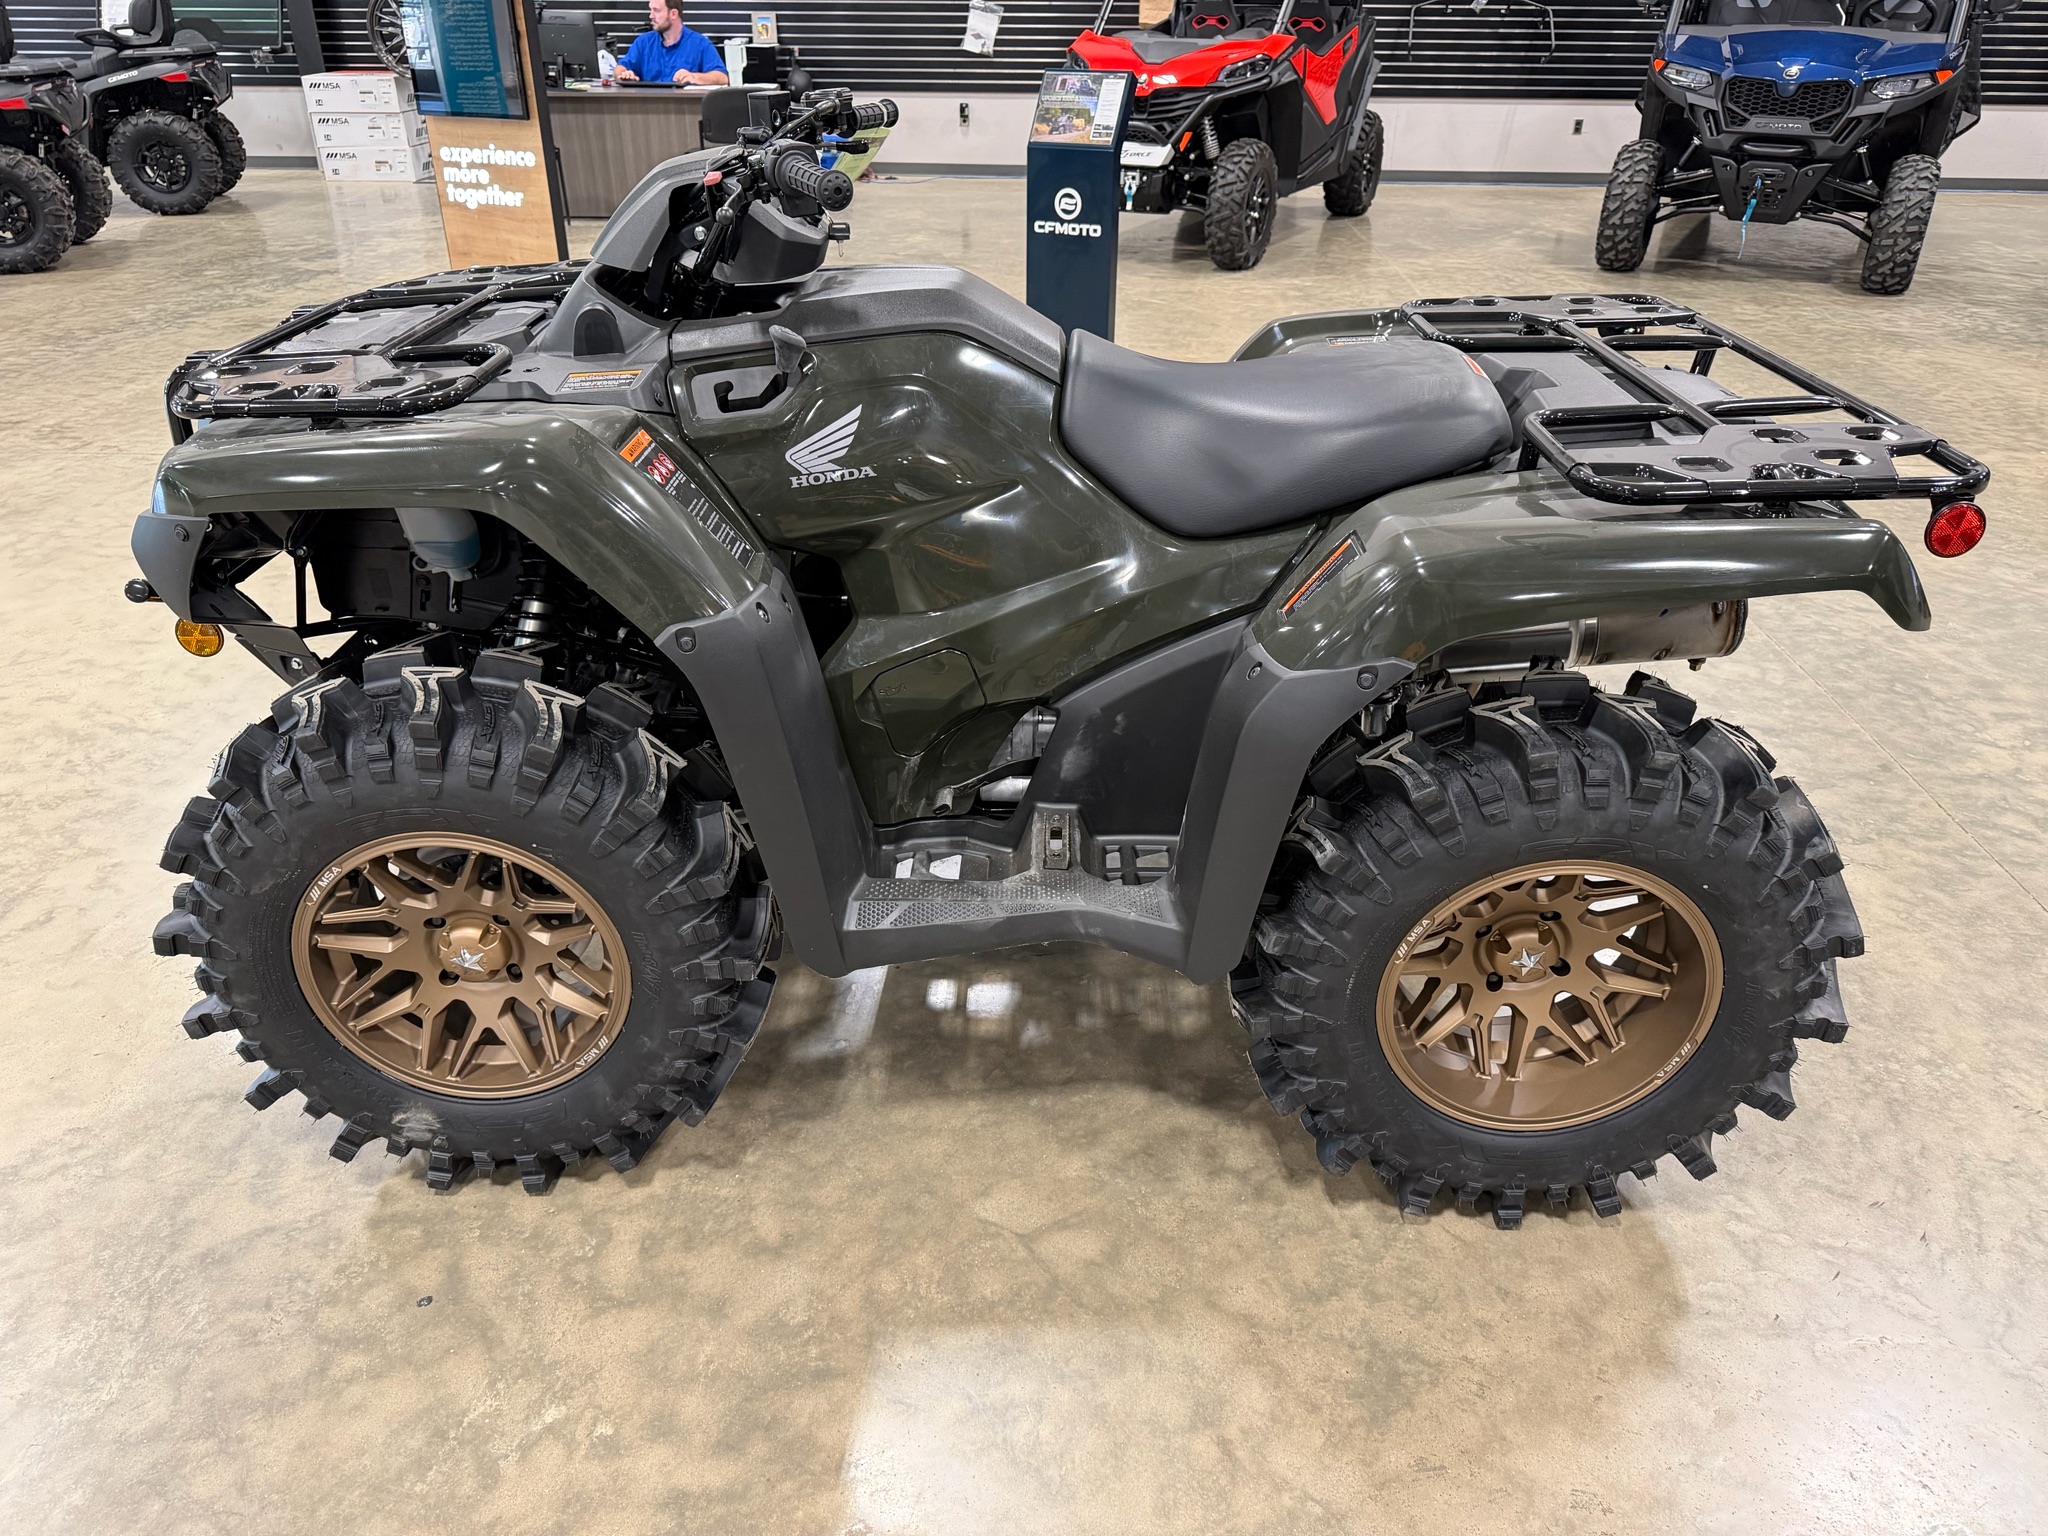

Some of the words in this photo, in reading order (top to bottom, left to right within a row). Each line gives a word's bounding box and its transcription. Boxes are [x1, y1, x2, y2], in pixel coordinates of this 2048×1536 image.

[108, 70, 139, 83] CFMOTO
[331, 117, 350, 125] MSA
[339, 152, 357, 160] MSA
[439, 143, 536, 168] experience
[443, 166, 490, 185] more
[446, 183, 524, 210] together
[1033, 220, 1102, 238] CFMOTO
[789, 466, 877, 488] HONDA
[317, 866, 342, 888] MSA
[1406, 919, 1431, 942] MSA
[575, 1047, 600, 1066] MSA
[1656, 1056, 1681, 1077] MSA
